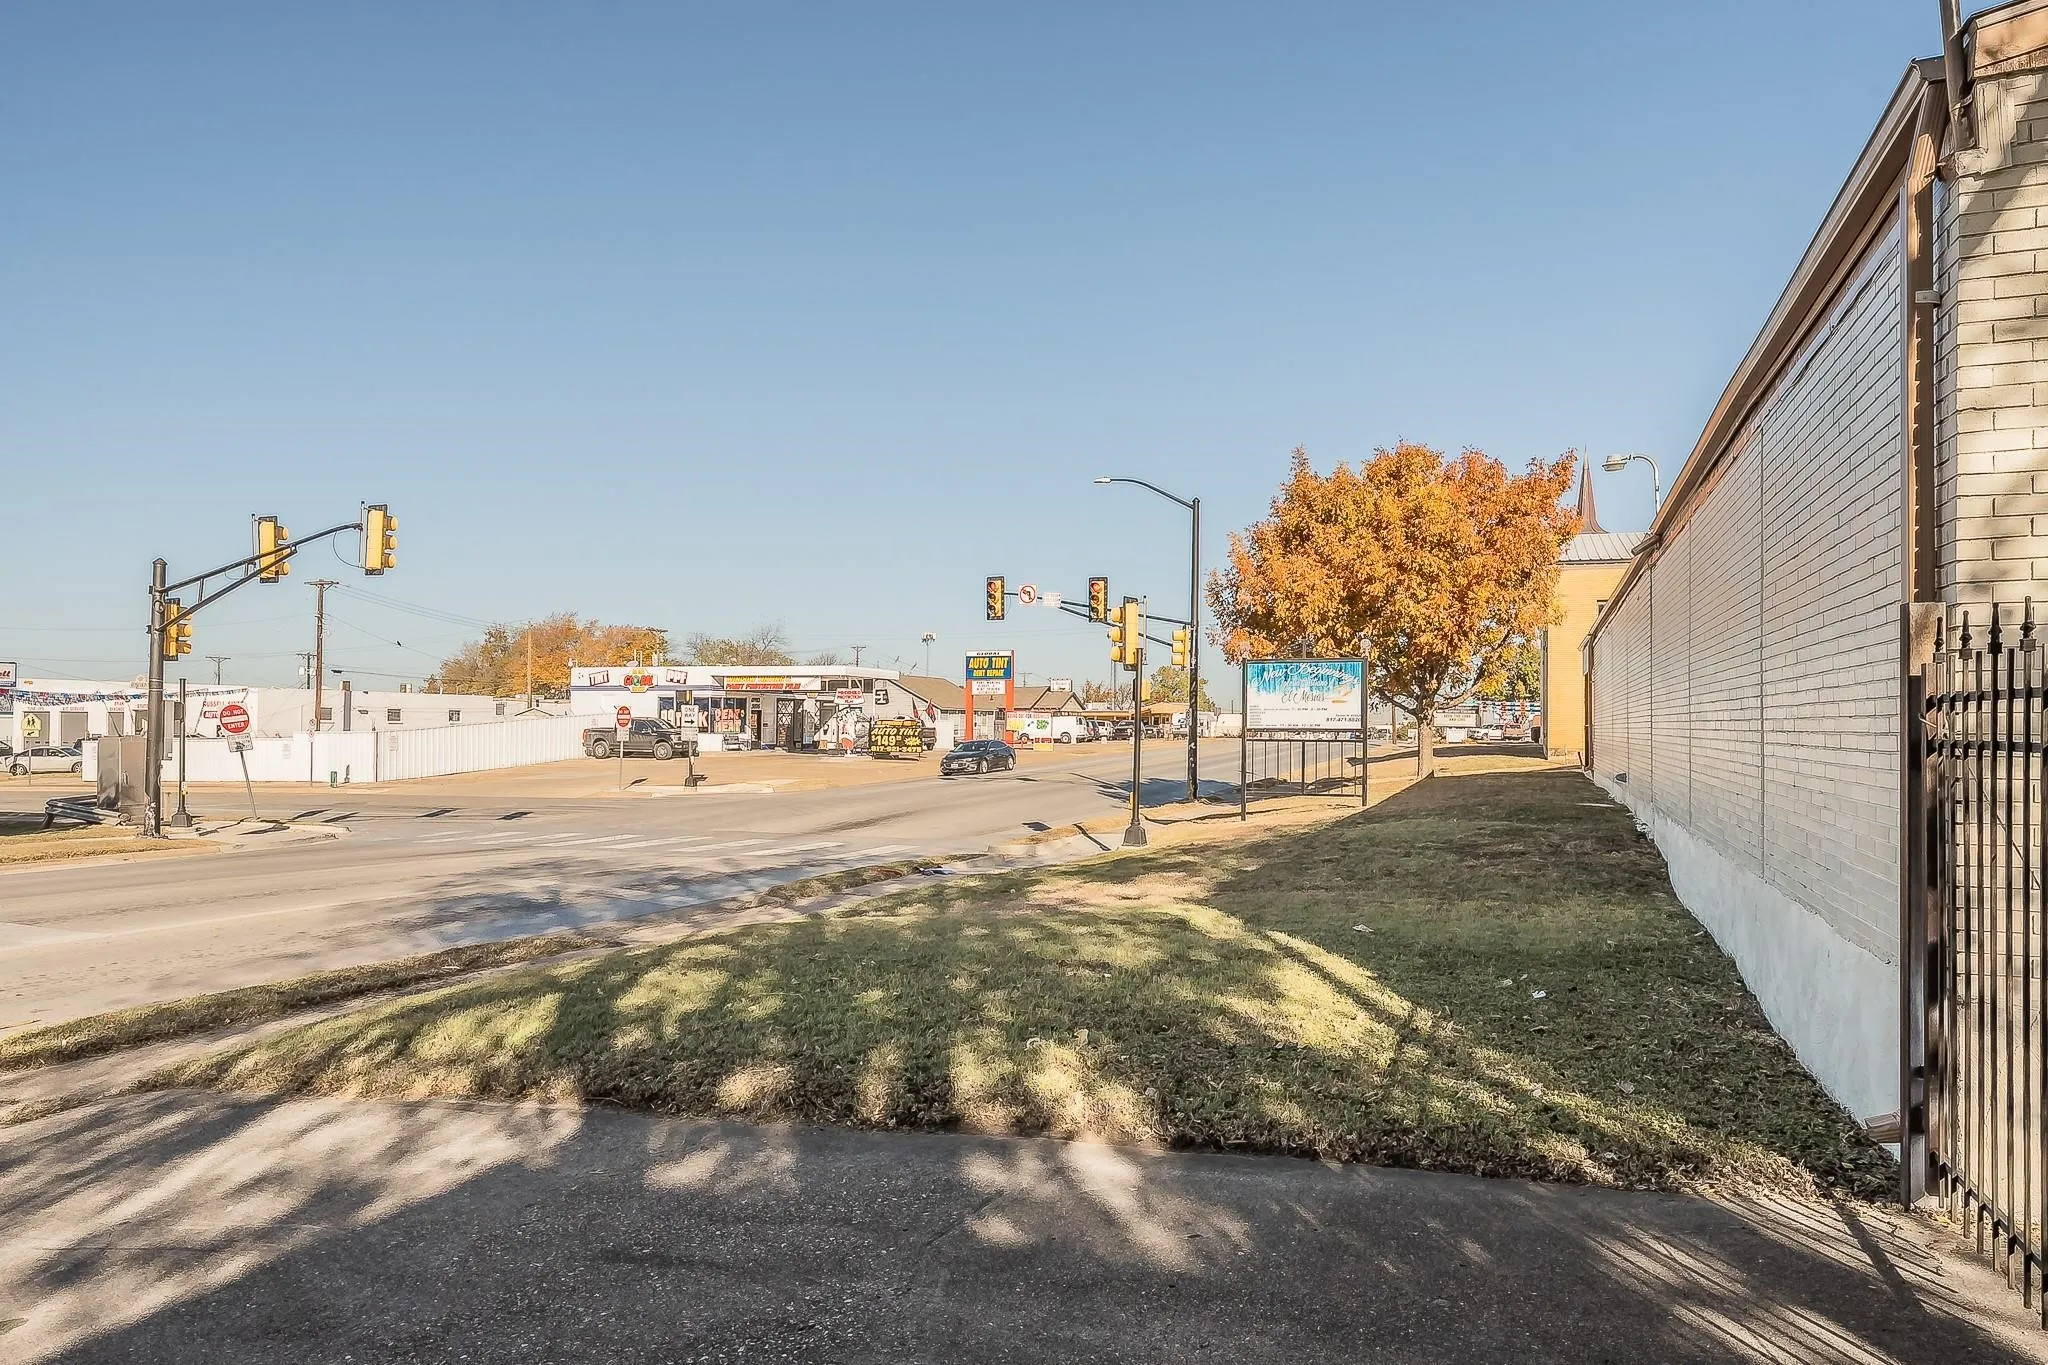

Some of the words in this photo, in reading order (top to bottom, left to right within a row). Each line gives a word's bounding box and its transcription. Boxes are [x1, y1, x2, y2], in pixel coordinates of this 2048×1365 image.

[968, 657, 990, 669] AUTO
[991, 657, 1009, 669] TINT
[871, 727, 898, 736] AUTO
[898, 727, 922, 736] TINT
